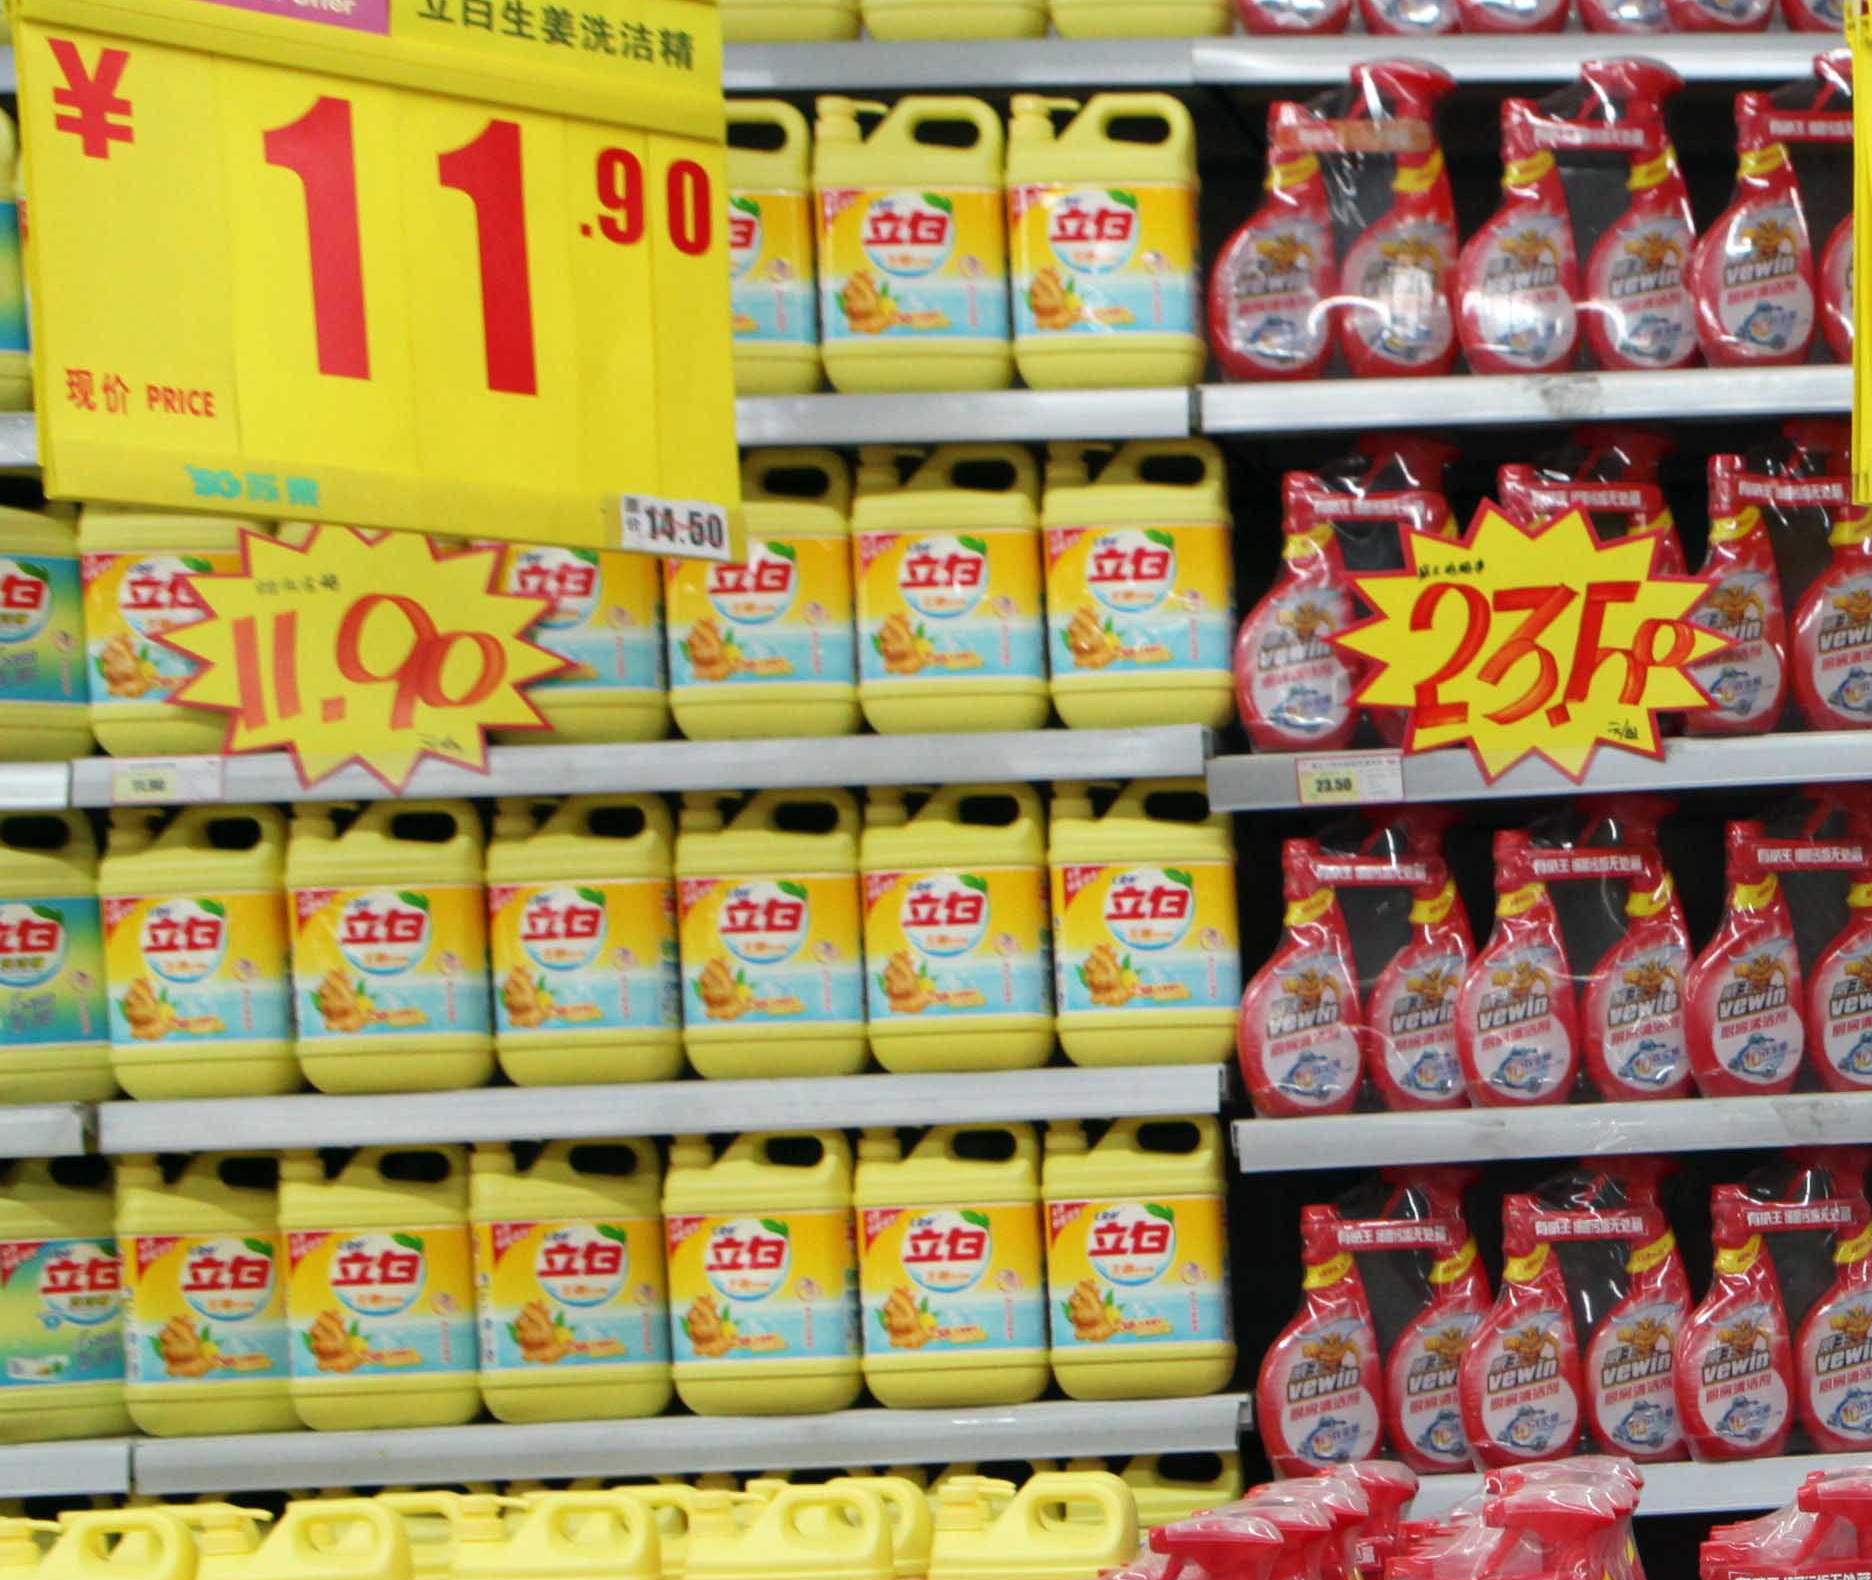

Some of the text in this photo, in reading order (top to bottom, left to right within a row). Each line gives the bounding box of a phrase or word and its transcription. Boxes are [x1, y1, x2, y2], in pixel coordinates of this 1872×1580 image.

[65, 369, 216, 418] 现价 PRICE
[645, 505, 724, 549] 14.50
[233, 593, 507, 732] 11.90
[1410, 580, 1697, 730] 23.50
